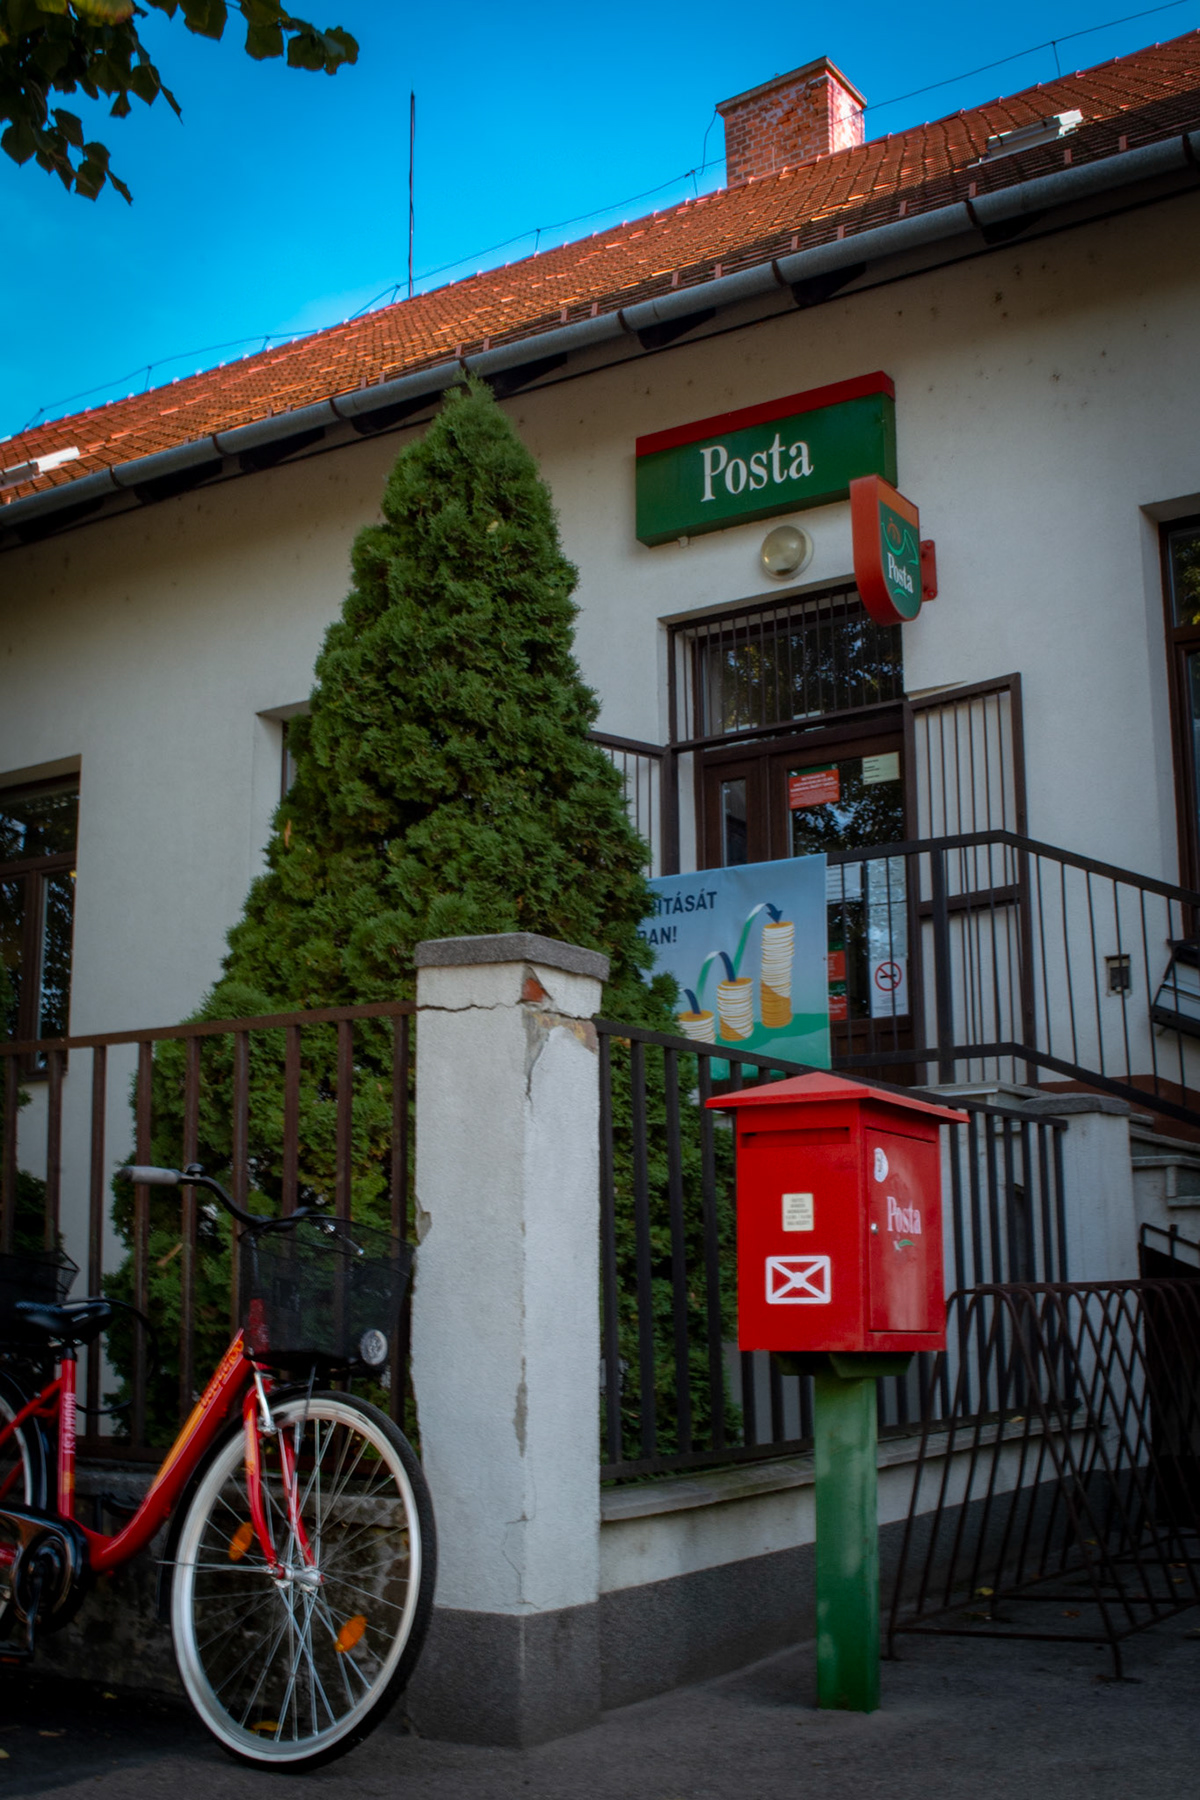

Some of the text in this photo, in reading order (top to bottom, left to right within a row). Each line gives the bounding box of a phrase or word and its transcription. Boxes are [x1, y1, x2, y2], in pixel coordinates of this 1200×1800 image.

[700, 433, 814, 502] Posta
[888, 552, 913, 593] Posta
[887, 1196, 921, 1234] Posta
